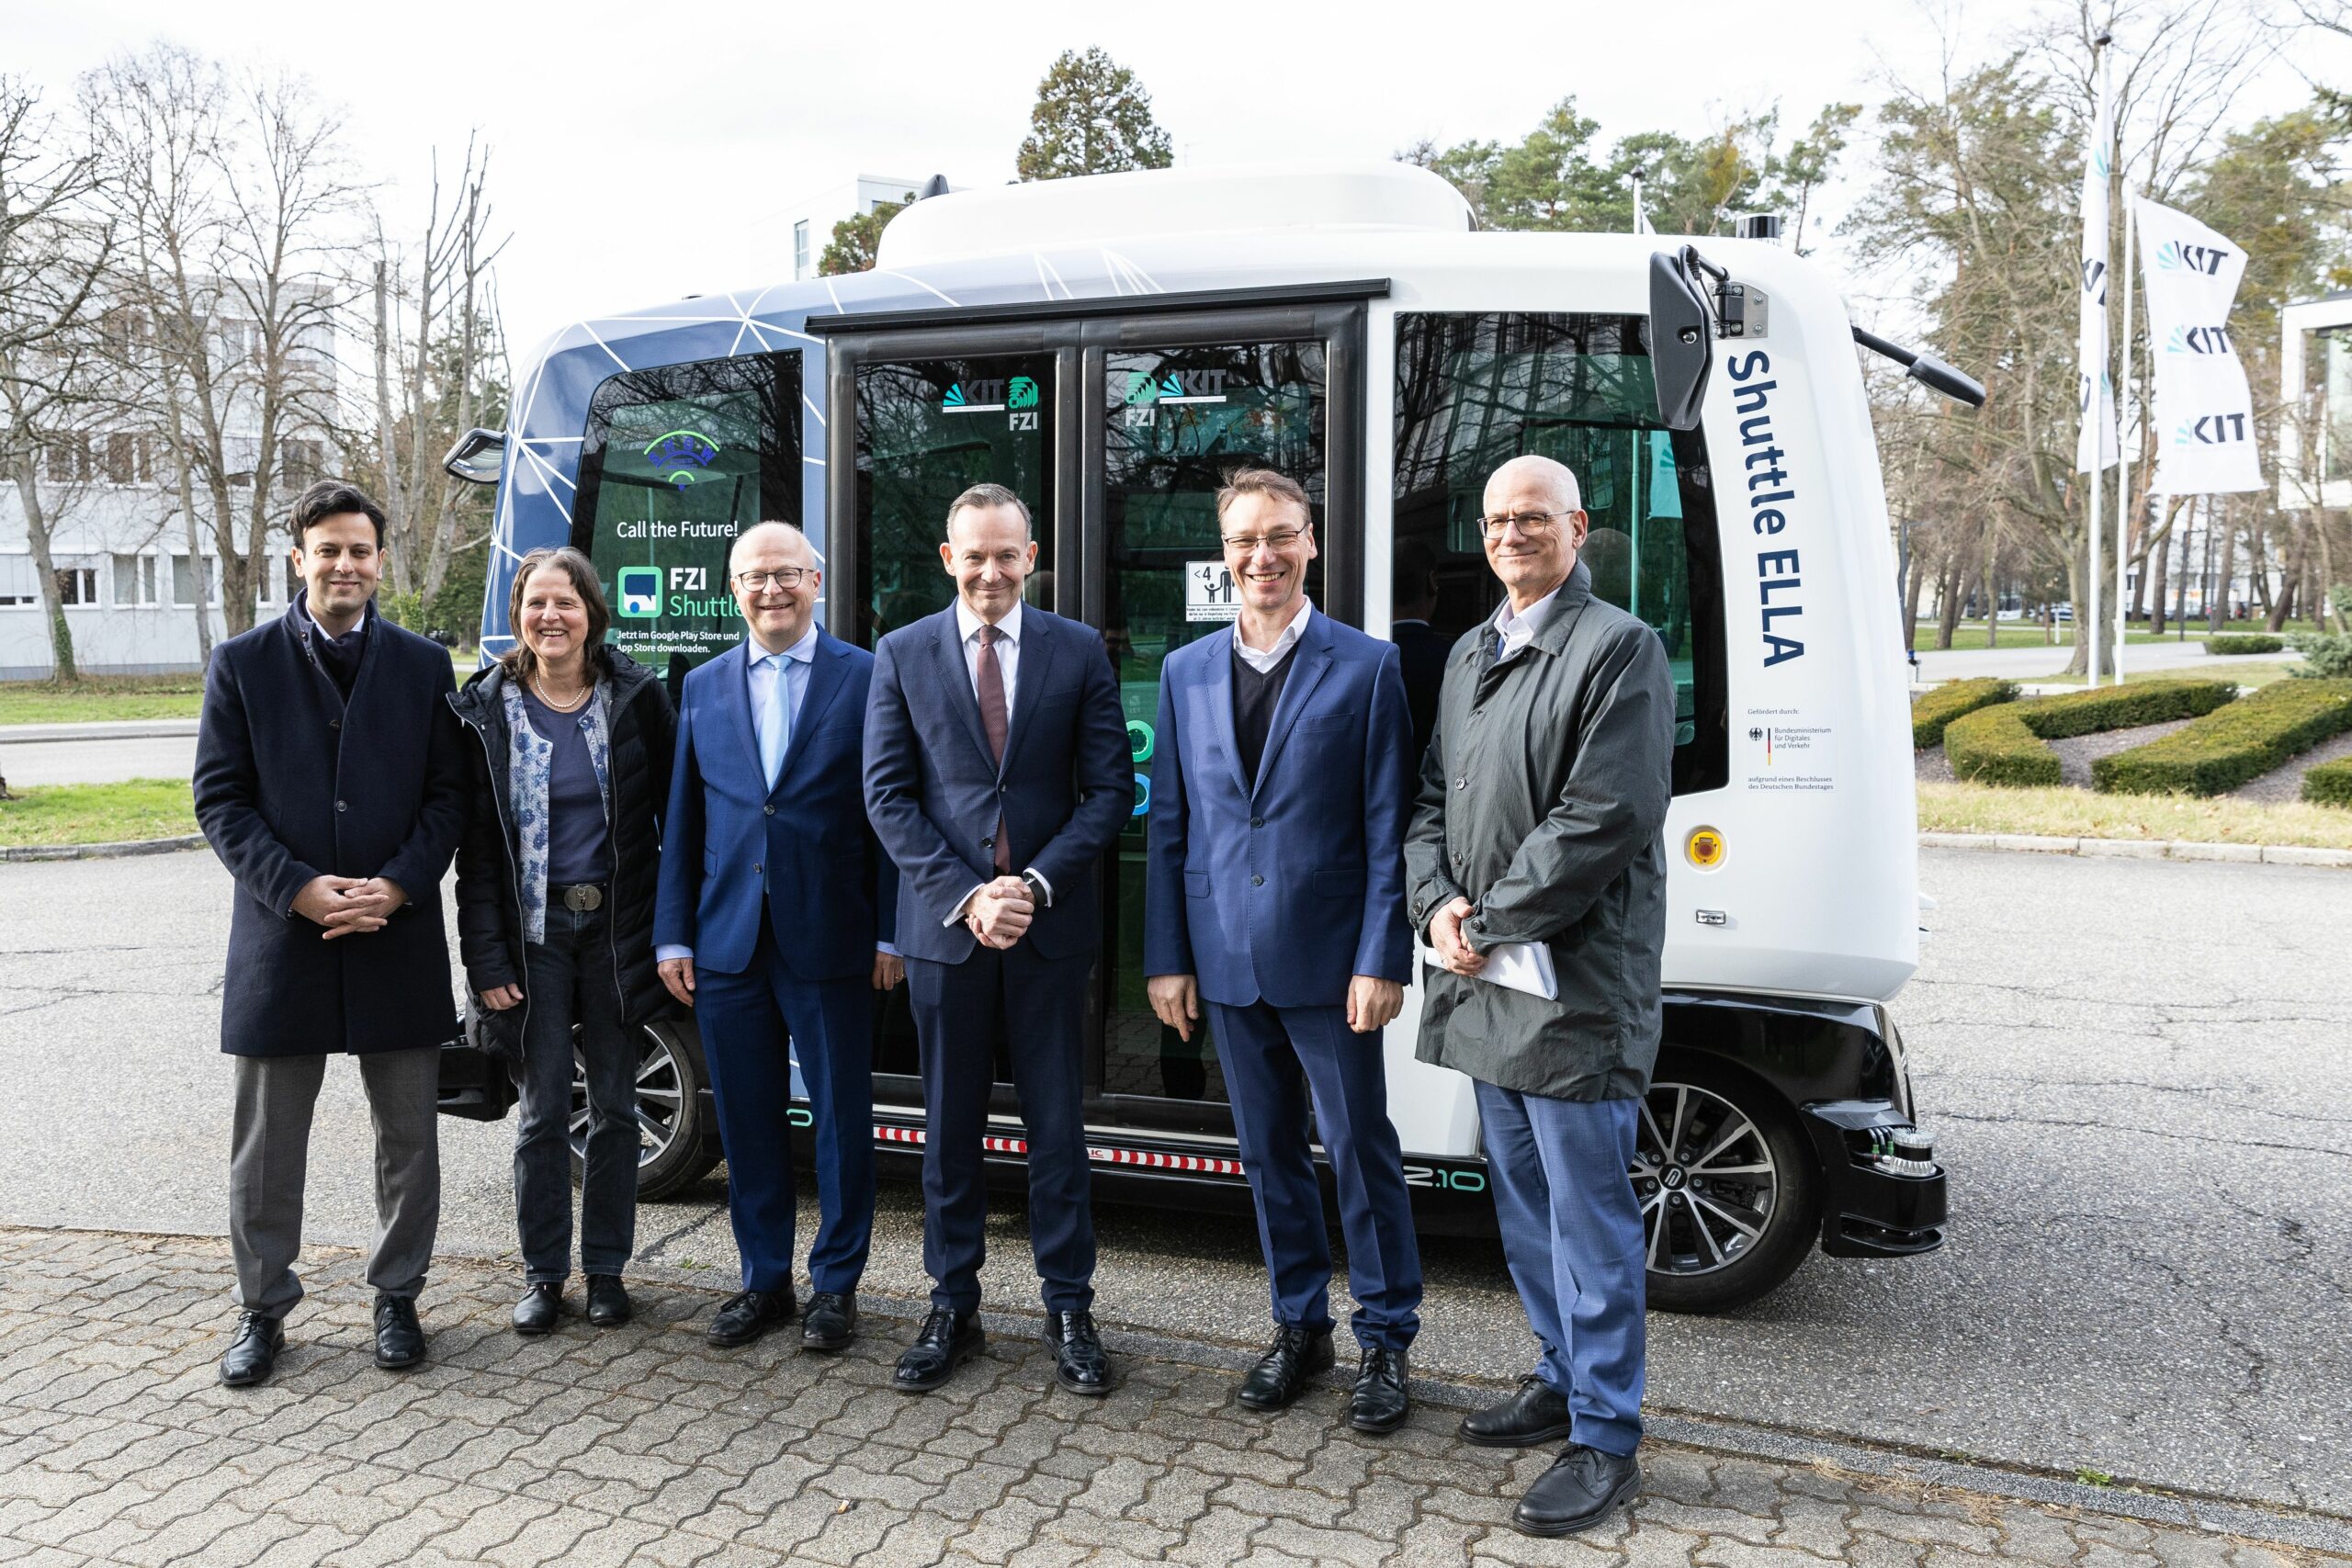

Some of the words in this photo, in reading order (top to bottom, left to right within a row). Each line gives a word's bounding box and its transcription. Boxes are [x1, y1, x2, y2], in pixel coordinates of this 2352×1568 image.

[2174, 240, 2229, 276] KIT
[2186, 326, 2228, 355] KIT
[960, 378, 1004, 405] KIT
[1177, 369, 1227, 395] KIT
[1010, 412, 1037, 431] FZI
[1125, 409, 1155, 426] FZI
[2193, 412, 2245, 445] KIT
[1727, 350, 1795, 536] Shuttle
[616, 520, 647, 538] Call
[650, 520, 677, 537] the
[681, 520, 739, 537] Future!
[670, 567, 707, 591] FZI
[669, 593, 742, 617] Shuttle
[1758, 549, 1804, 668] ELLA
[616, 630, 638, 639] Jetzt
[638, 631, 649, 639] im
[650, 631, 679, 642] Google
[680, 631, 697, 642] Play
[699, 631, 722, 641] Store
[723, 631, 740, 640] und
[616, 644, 632, 653] App
[634, 643, 656, 652] Store
[657, 644, 711, 653] downloaden.
[1784, 735, 1811, 743] Digitales
